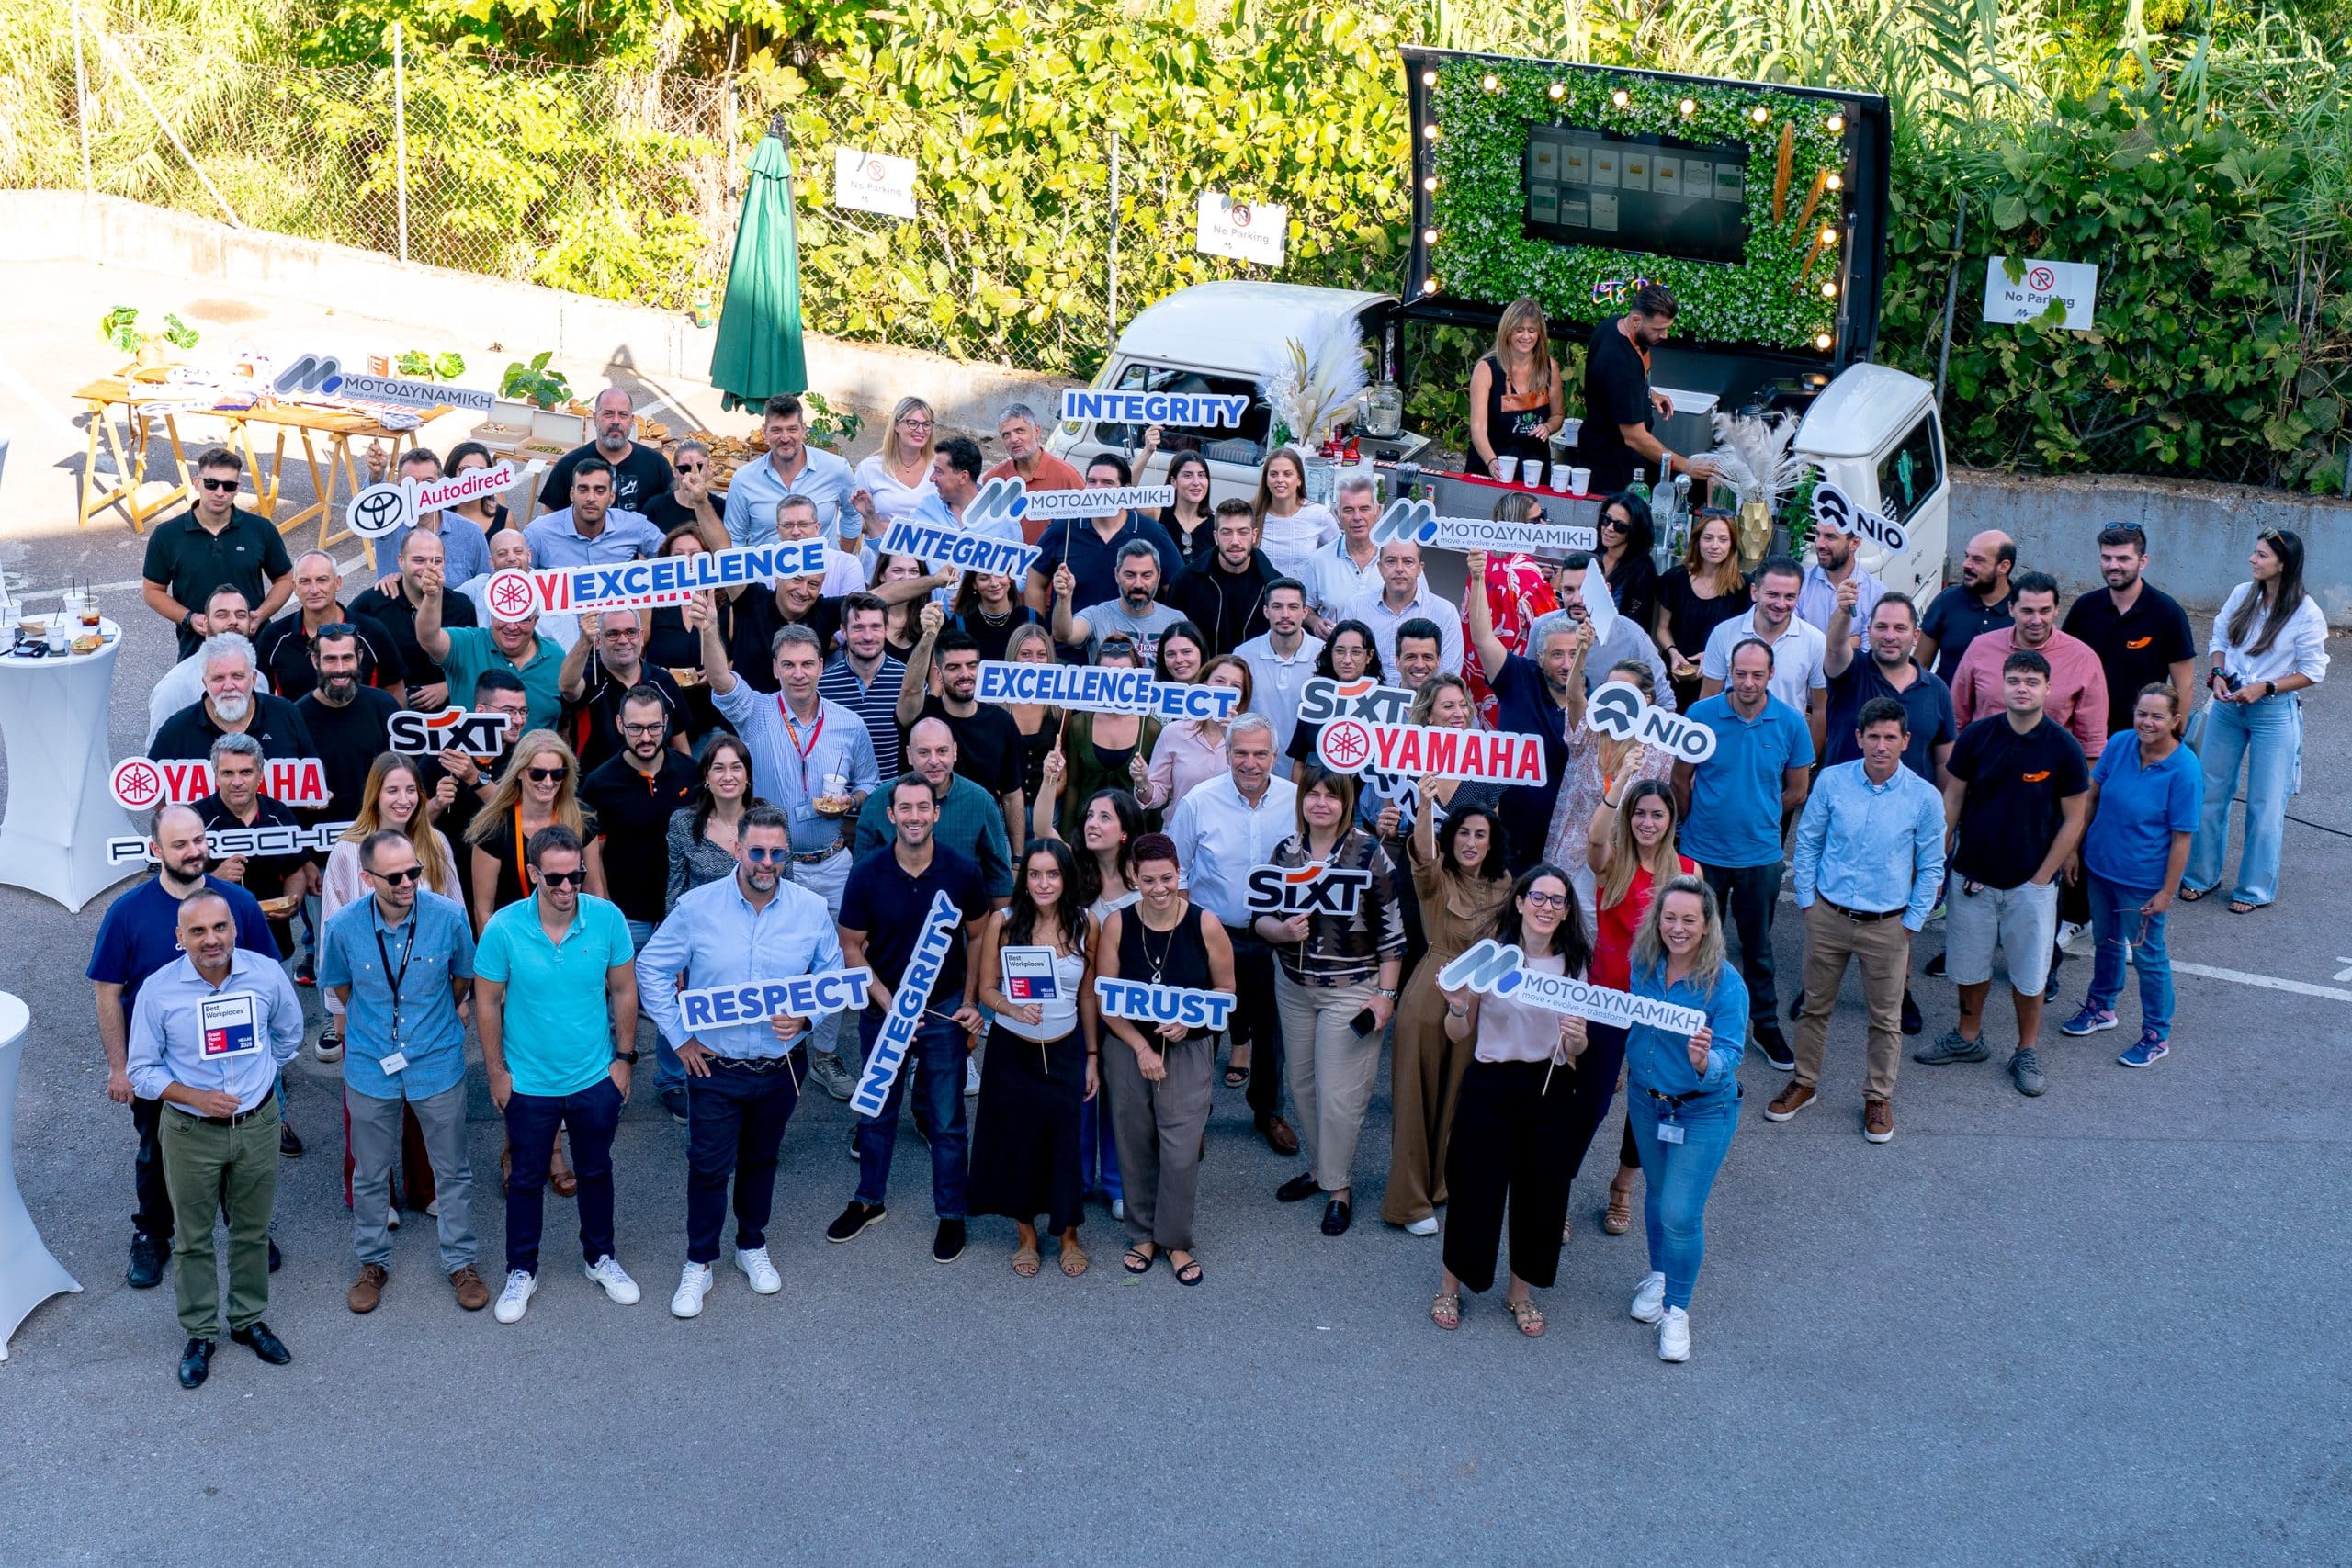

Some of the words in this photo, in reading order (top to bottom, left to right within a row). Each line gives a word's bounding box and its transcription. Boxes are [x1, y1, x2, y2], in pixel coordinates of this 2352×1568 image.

[1213, 225, 1228, 235] No
[1231, 228, 1269, 245] Parking
[2005, 291, 2023, 302] No
[344, 391, 363, 400] move
[369, 394, 393, 403] evolve
[399, 397, 433, 407] transform
[345, 377, 492, 409] ΜΟΤΟΔΥΝΑΜΙΚΗ
[1066, 393, 1245, 424] INTEGRITY
[419, 468, 510, 508] Autodirect
[1031, 490, 1171, 509] ΜΟΤΟΔΥΝΑΜΙΚΗ
[886, 522, 1038, 575] INTEGRITY
[1440, 522, 1592, 547] ΜΟΤΟΔΥΝΑΜΙΚΗ
[1496, 541, 1532, 550] transform
[1857, 512, 1903, 549] NIO
[573, 543, 825, 601] EXCELLENCE
[1139, 643, 1157, 652] JEAN
[980, 666, 1152, 703] EXCELLENCE
[1301, 680, 1412, 724] SIXT
[391, 711, 506, 753] SIXT
[1645, 713, 1707, 756] NIO
[1375, 727, 1541, 781] YAMAHA
[163, 764, 322, 801] YAHA
[1248, 866, 1368, 911] SIXT
[684, 972, 868, 1026] RESPECT
[857, 896, 958, 1111] INTEGRITY
[1099, 982, 1231, 1026] TRUST
[1522, 991, 1545, 1003] move
[1553, 998, 1579, 1012] evolve
[1587, 1008, 1627, 1023] transform
[1525, 974, 1701, 1031] ΜΟΤΟΔΥΝΑΜΙΚΗ
